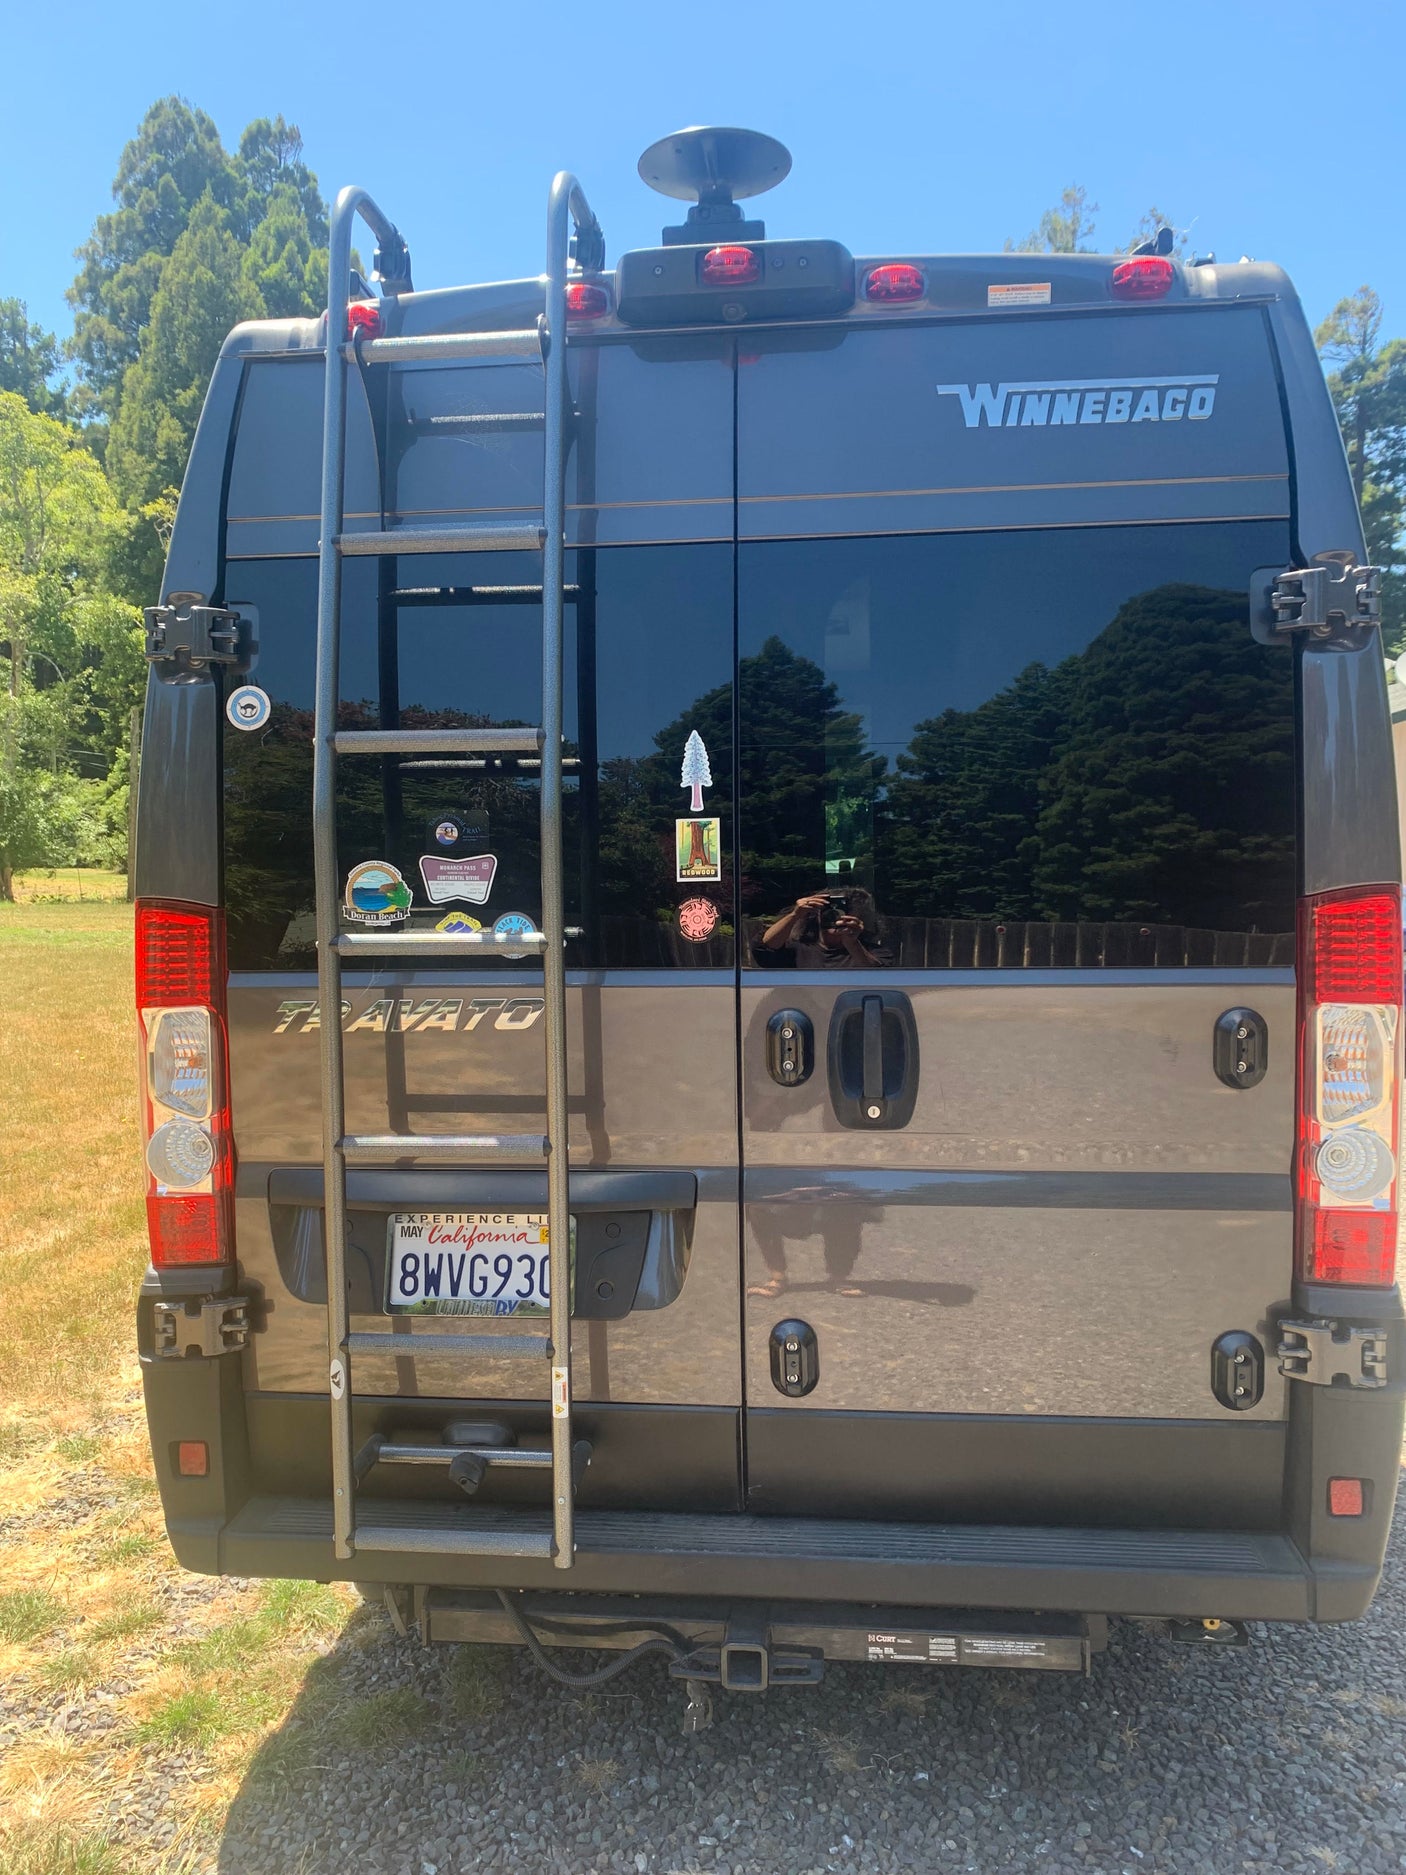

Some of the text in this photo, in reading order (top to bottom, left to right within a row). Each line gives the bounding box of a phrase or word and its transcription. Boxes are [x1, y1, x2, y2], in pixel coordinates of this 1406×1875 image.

[936, 374, 1220, 428] WINNEBAGO
[350, 910, 403, 920] Doran Beach
[516, 917, 531, 930] TIDE
[395, 1214, 550, 1224] EXPERIENCE LI
[400, 1225, 424, 1238] MAY
[428, 1225, 541, 1251] California
